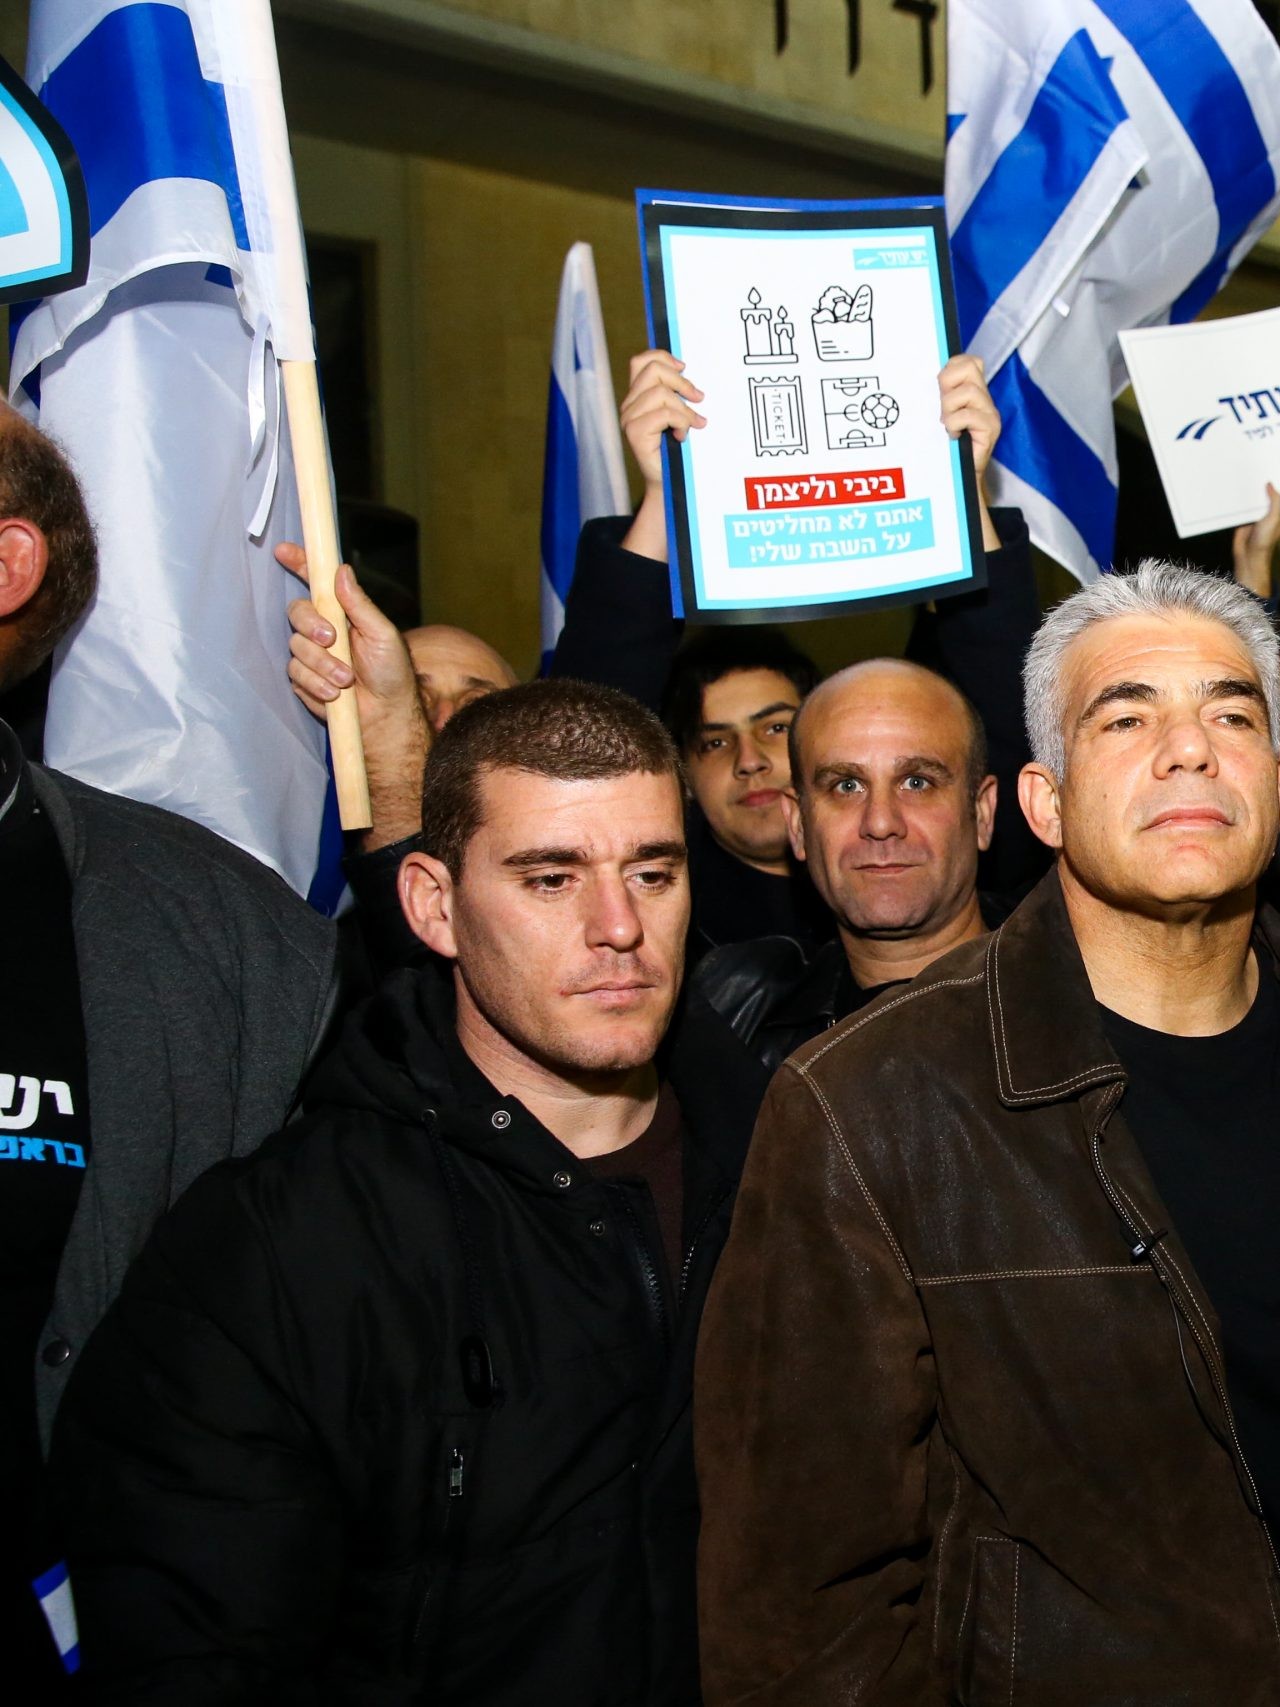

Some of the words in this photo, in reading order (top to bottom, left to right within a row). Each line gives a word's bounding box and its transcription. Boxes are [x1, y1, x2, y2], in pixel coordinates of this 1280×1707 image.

[771, 393, 786, 439] TICKET
[754, 476, 837, 509] וליצמן
[843, 475, 897, 497] ביבי
[732, 513, 832, 538] מחליטים
[838, 508, 867, 530] לא
[875, 505, 924, 528] אתם
[749, 541, 801, 563] שלי!
[809, 536, 877, 560] השבת
[882, 531, 912, 550] על
